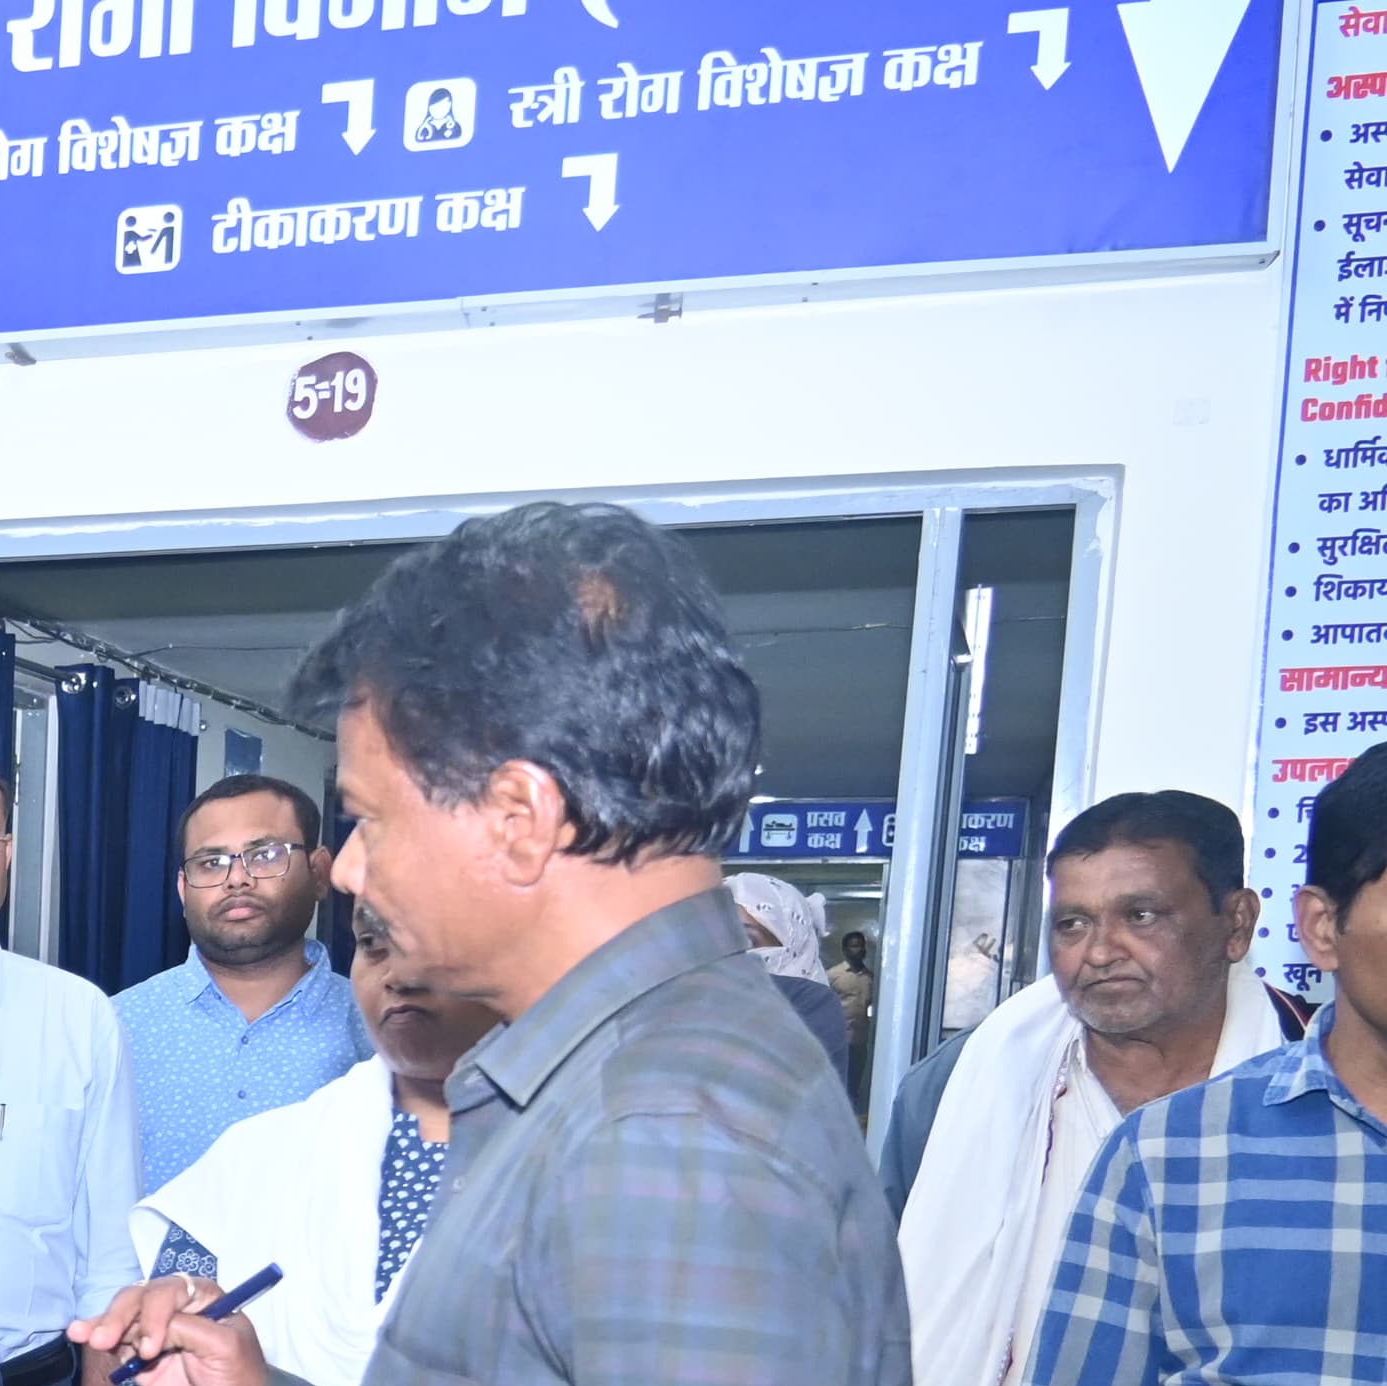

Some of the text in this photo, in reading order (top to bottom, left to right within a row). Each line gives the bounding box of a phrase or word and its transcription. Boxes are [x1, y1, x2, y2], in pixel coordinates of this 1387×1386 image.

[508, 41, 984, 129] स्त्री रोग विशेषज्ञ कक्ष
[1327, 71, 1387, 100] अस्प
[56, 116, 204, 175] विशेषज्ञ
[213, 109, 302, 159] कक्ष
[211, 186, 526, 254] टीकाकरण कक्ष
[1333, 296, 1354, 324] में
[1303, 354, 1379, 386] Right
[1300, 392, 1387, 422] Confid
[1323, 435, 1387, 469] धार्मि
[1318, 491, 1352, 513] का
[1316, 528, 1387, 566] सुरक्षि
[1313, 574, 1387, 602] शिकाय
[1310, 622, 1387, 644] आपात
[1303, 712, 1341, 735] इस
[806, 811, 847, 828] प्रसव
[807, 833, 842, 849] कक्ष
[1292, 844, 1308, 864] 2
[1283, 963, 1323, 992] खून
